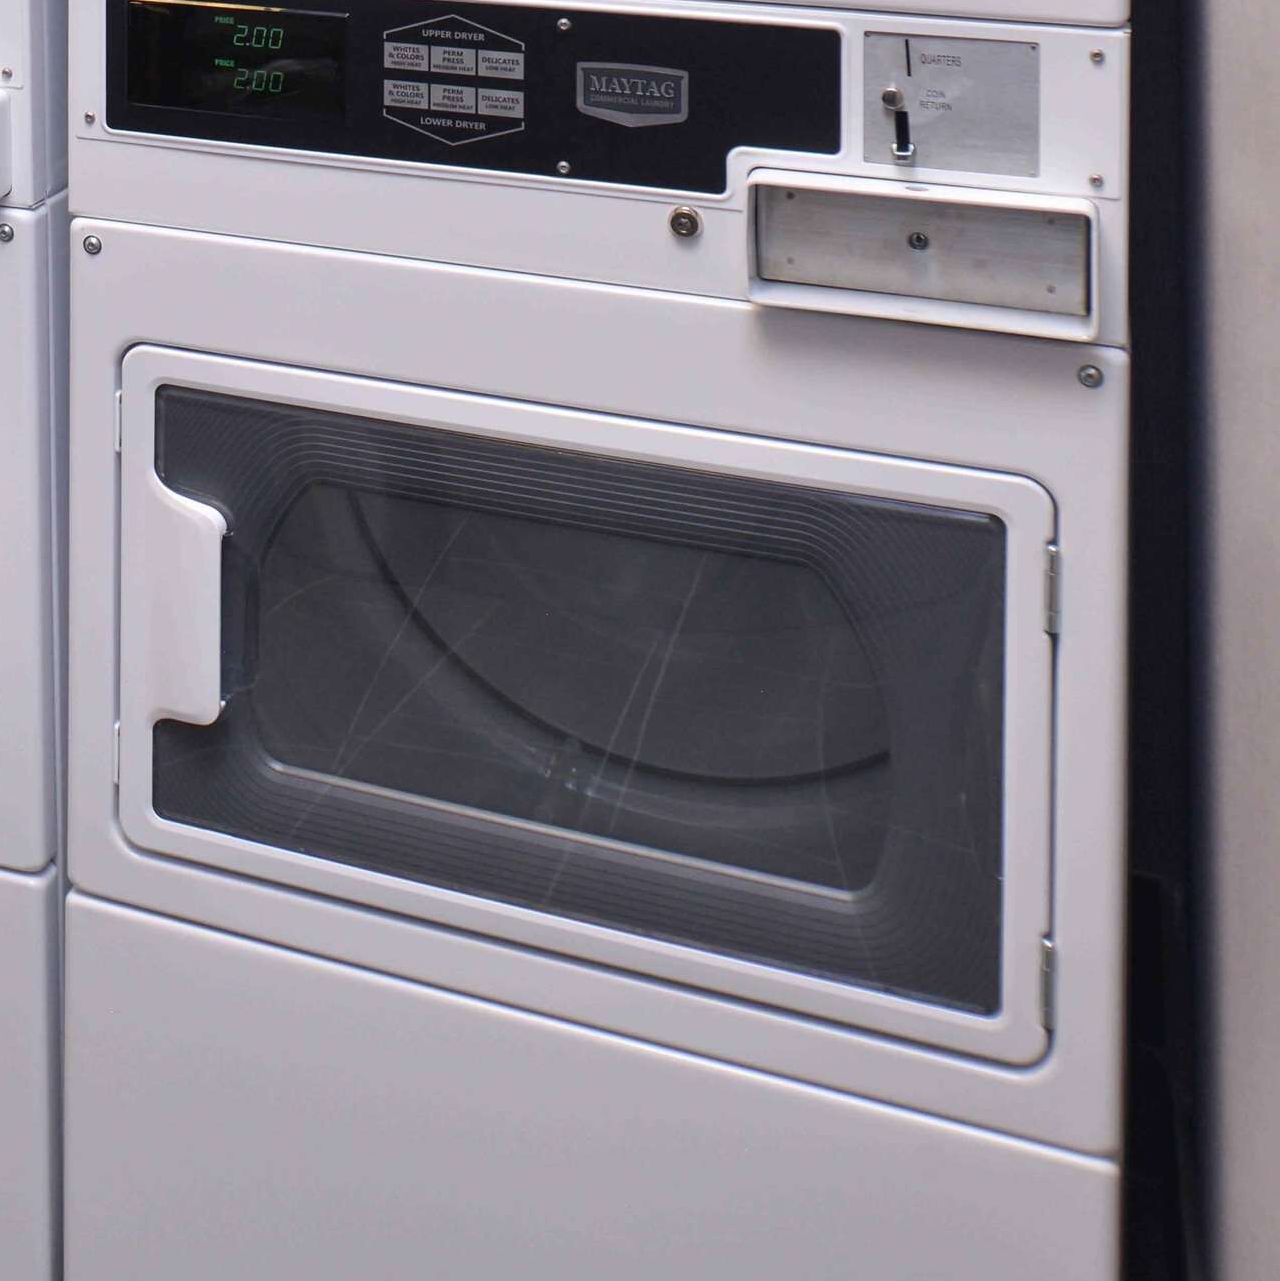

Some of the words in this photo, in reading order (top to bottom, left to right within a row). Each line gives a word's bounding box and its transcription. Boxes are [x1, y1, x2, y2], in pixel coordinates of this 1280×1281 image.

[232, 24, 284, 50] 2.00
[422, 28, 452, 39] UPPER
[454, 30, 485, 41] DRYER
[392, 45, 421, 54] WHITES
[396, 53, 425, 62] COLORS
[442, 57, 465, 65] PRESS
[481, 56, 521, 66] DELICATES
[920, 53, 962, 67] QUARTERS
[233, 68, 284, 93] 2.00
[392, 83, 421, 92] WHITES
[589, 74, 675, 98] MAYTAG
[395, 91, 425, 100] COLORS
[442, 88, 464, 96] PERM
[442, 95, 465, 103] PRESS
[481, 94, 521, 104] DELICATES
[919, 100, 953, 111] RETURN
[420, 117, 453, 128] LOWER
[455, 119, 486, 131] DRYER
